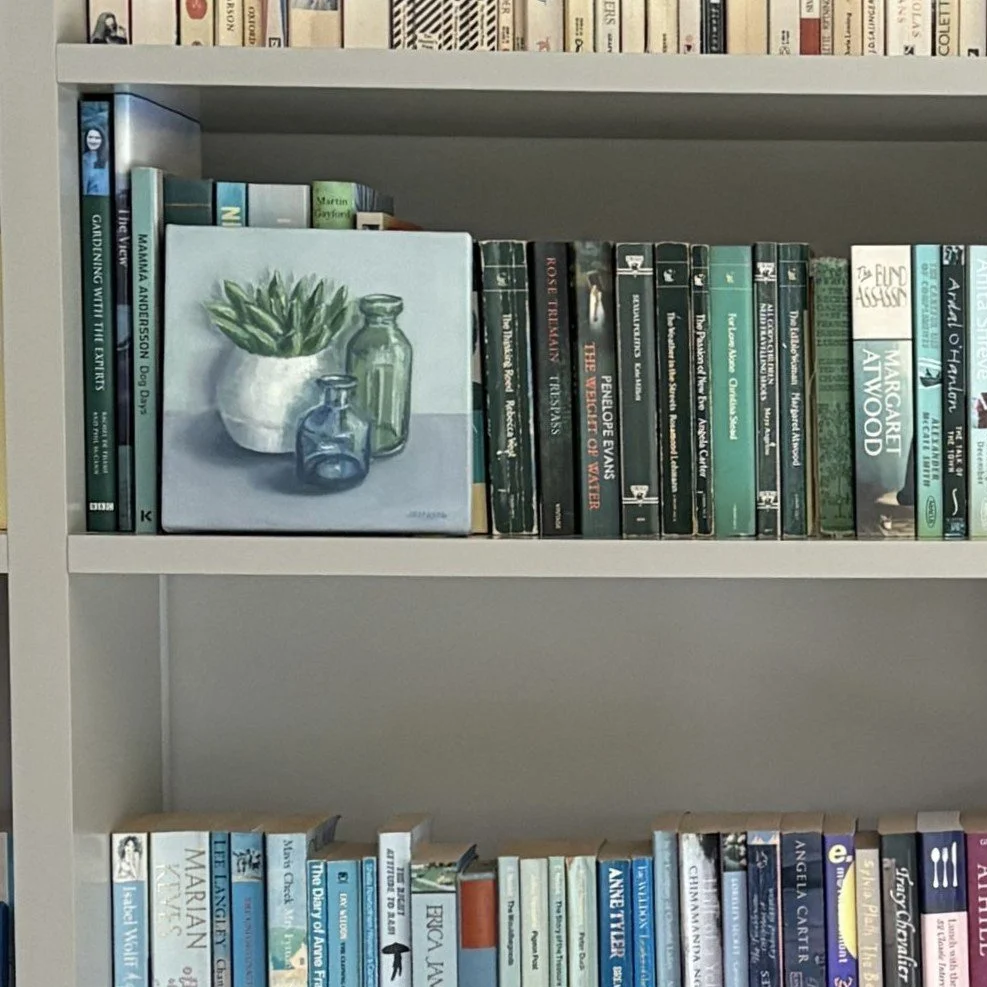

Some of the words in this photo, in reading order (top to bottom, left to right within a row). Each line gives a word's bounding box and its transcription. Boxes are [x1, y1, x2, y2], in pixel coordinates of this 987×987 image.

[92, 215, 103, 283] GARDENING
[137, 234, 148, 281] MAMMA
[546, 257, 558, 294] ROSE
[93, 288, 104, 318] WITH
[138, 286, 149, 359] ANDERSSON
[503, 314, 512, 329] The
[93, 322, 104, 342] THE
[503, 331, 513, 368] Thinking
[548, 300, 559, 362] TREMAIN
[94, 347, 105, 391] EXPERTS
[138, 366, 149, 386] Dog
[584, 342, 596, 372] THE
[504, 370, 513, 392] Reed
[862, 348, 881, 456] ATWOOD
[138, 390, 149, 415] Days
[505, 400, 515, 437] Rebecca
[550, 375, 560, 435] TRESPASS
[585, 376, 597, 434] WEIGHT
[602, 376, 613, 437] PENELOPE
[885, 348, 901, 457] MARGARET
[507, 438, 517, 457] West
[588, 439, 598, 457] OF
[603, 440, 615, 480] EVANS
[588, 462, 600, 510] WATER
[312, 864, 324, 886] The
[609, 868, 623, 908] ANNE
[795, 840, 806, 900] ANGELA
[890, 867, 913, 909] Tracy
[183, 849, 207, 950] MARIAN
[310, 888, 325, 921] Diary
[689, 866, 700, 962] CHIMAMANDA
[313, 922, 325, 934] of
[426, 905, 444, 952] ERICA
[609, 913, 625, 959] TYLER
[797, 906, 809, 964] CARTER
[897, 910, 917, 982] Chevalier
[313, 935, 325, 967] Anne
